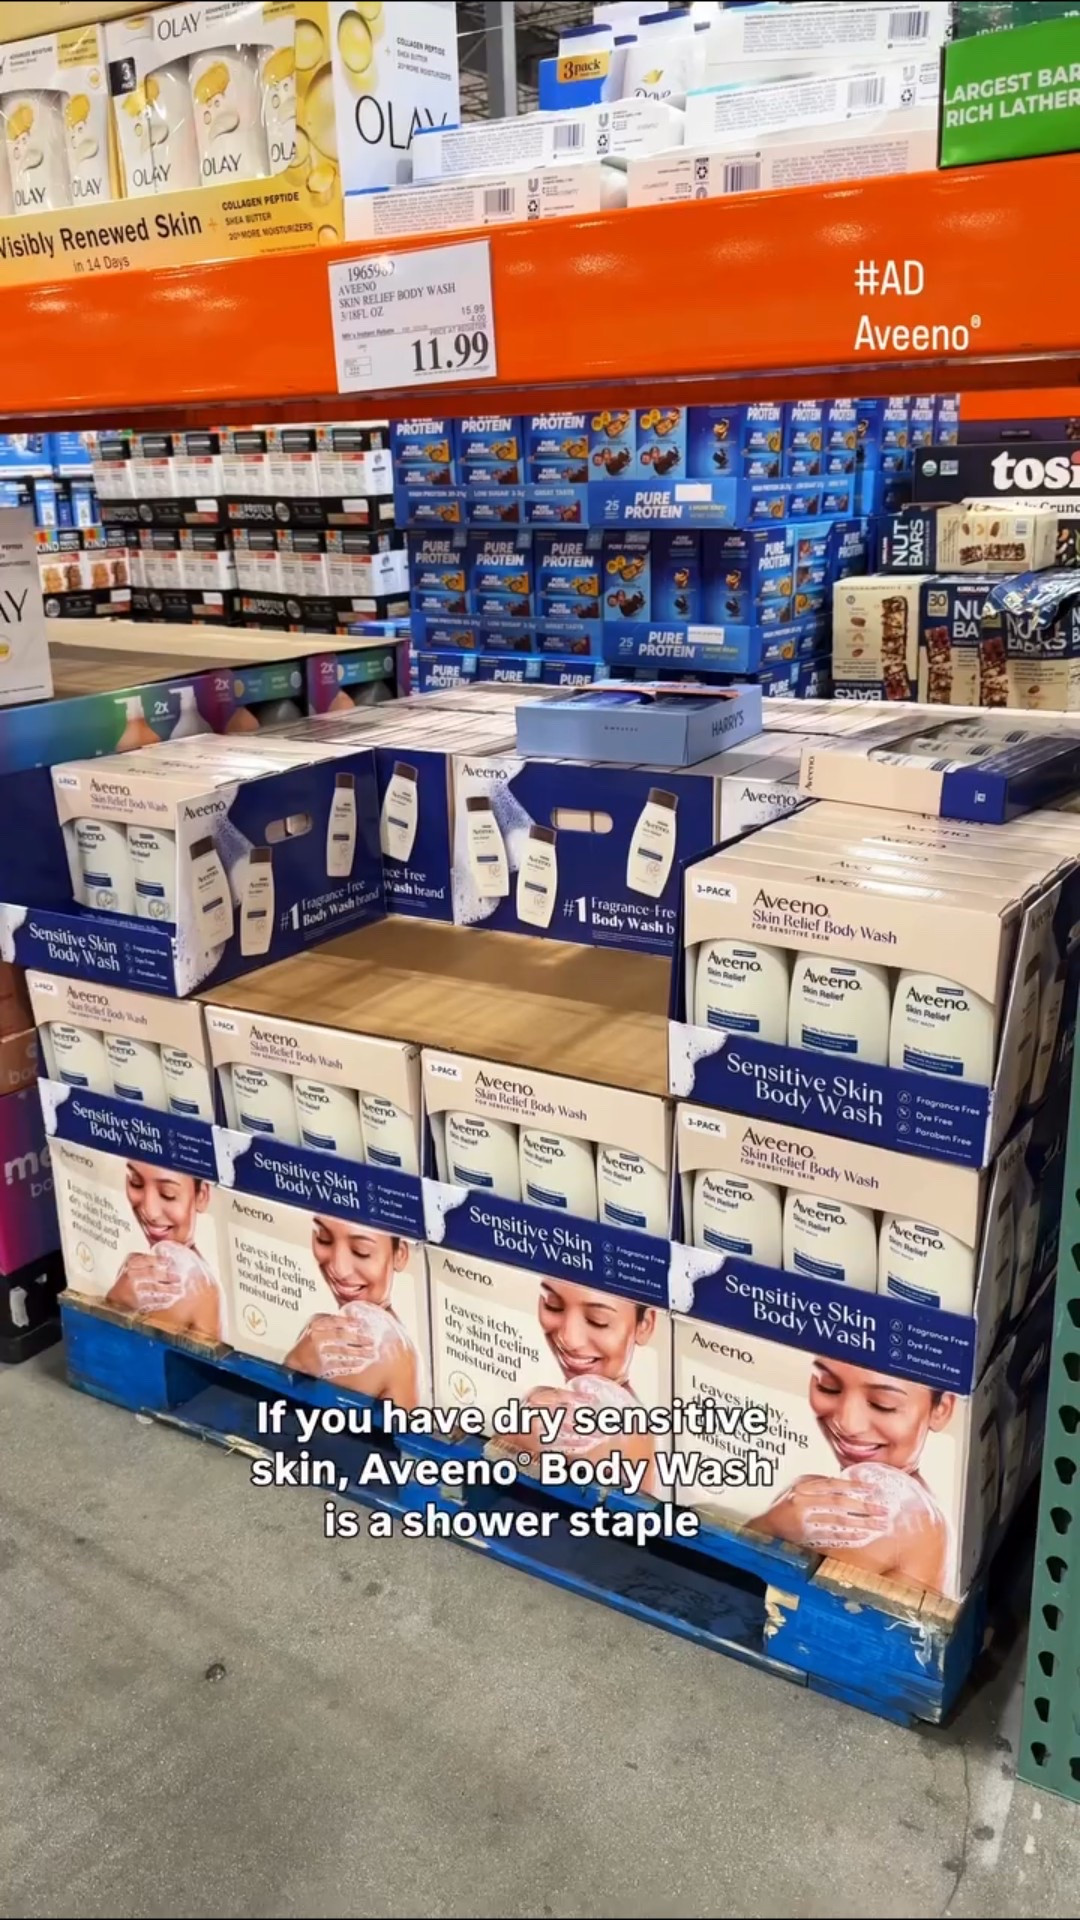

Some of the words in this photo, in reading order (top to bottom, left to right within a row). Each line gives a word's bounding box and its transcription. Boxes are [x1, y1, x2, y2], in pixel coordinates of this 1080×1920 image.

[157, 11, 201, 41] OLAY
[121, 62, 131, 81] 3
[944, 72, 1032, 105] LARGEST
[946, 103, 993, 128] RICH
[132, 163, 172, 187] OLAY
[202, 153, 242, 177] OLAY
[15, 187, 46, 207] OLAY
[222, 196, 262, 211] COLLAGEN
[264, 191, 300, 205] PEPTIDE
[60, 217, 150, 251] Renewed
[155, 211, 202, 239] Skin
[225, 215, 244, 226] SHEA
[245, 212, 272, 223] BUTTER
[262, 222, 314, 236] MOISTURIZERS
[73, 259, 85, 272] in
[87, 258, 101, 271] 14
[104, 255, 130, 271] Days
[338, 281, 377, 296] AVEENO
[339, 297, 361, 309] SKIN
[363, 291, 395, 306] RELIEF
[397, 286, 424, 301] BODY
[426, 282, 456, 295] WASH
[370, 306, 384, 318] OZ
[461, 303, 485, 316] 15.99
[411, 331, 489, 373] 11.99
[604, 500, 620, 511] 25
[634, 491, 671, 505] PURE
[624, 505, 683, 519] PROTEIN
[422, 540, 450, 552] PURE
[484, 541, 514, 554] PURE
[551, 543, 583, 555] PURE
[892, 520, 909, 566] NUT
[909, 519, 924, 566] BARS
[415, 552, 460, 564] PROTEIN
[476, 554, 525, 566] PROTEIN
[542, 555, 594, 568] PROTEIN
[928, 593, 946, 608] 30
[618, 637, 634, 648] 25
[648, 631, 684, 645] PURE
[638, 644, 696, 658] PROTEIN
[432, 664, 460, 676] PURE
[711, 709, 745, 737] HARRY'S
[696, 884, 732, 898] 3-PACK
[752, 888, 829, 918] Aveeno
[280, 902, 300, 931] #1
[302, 880, 366, 911] Fragrance-Free
[563, 896, 587, 923] #1
[29, 922, 87, 949] Sensitive
[751, 922, 767, 931] FOR
[769, 925, 809, 939] SENSITIVE
[811, 931, 830, 942] SKIN
[752, 909, 780, 925] Skin
[783, 913, 820, 931] Relief
[824, 920, 858, 938] Body
[860, 926, 898, 945] Wash
[47, 942, 81, 968] Body
[803, 967, 862, 991] Aveeno
[906, 986, 969, 1012] Aveeno
[249, 1025, 299, 1048] Aveeno
[270, 1045, 294, 1058] Relief
[474, 1070, 534, 1096] Aveeno
[726, 1052, 827, 1093] Sensitive
[832, 1075, 884, 1105] Skin
[498, 1092, 528, 1109] Relief
[756, 1080, 813, 1115] Body
[817, 1094, 883, 1126] Wash
[916, 1095, 960, 1114] Fragrance
[72, 1100, 129, 1130] Sensitive
[687, 1117, 721, 1133] 3-PACK
[915, 1111, 932, 1123] Dye
[125, 1131, 163, 1155] Wash
[741, 1126, 814, 1159] Aveeno
[915, 1127, 952, 1141] Paraben
[952, 1135, 972, 1147] Free
[253, 1151, 321, 1184] Sensitive
[324, 1171, 358, 1193] Skin
[740, 1157, 755, 1166] FOR
[757, 1162, 795, 1176] SENSITIVE
[741, 1145, 768, 1162] Skin
[770, 1152, 805, 1172] Relief
[809, 1160, 841, 1181] Body
[841, 1169, 879, 1189] Wash
[274, 1173, 313, 1200] Body
[315, 1184, 360, 1210] Wash
[469, 1205, 549, 1241] Sensitive
[552, 1227, 593, 1253] Skin
[234, 1237, 269, 1260] Leaves
[493, 1229, 538, 1260] Body
[542, 1243, 594, 1272] Wash
[616, 1245, 650, 1261] Fragrance
[236, 1252, 251, 1268] dry
[254, 1260, 276, 1276] skin
[277, 1267, 317, 1292] feeling
[237, 1268, 279, 1291] soothed
[281, 1285, 302, 1299] and
[442, 1258, 493, 1286] Aveeno
[239, 1281, 299, 1312] moisturized
[725, 1274, 822, 1317] Sensitive
[827, 1302, 876, 1332] Skin
[444, 1297, 485, 1325] Leaves
[486, 1315, 523, 1340] itchy,
[753, 1301, 808, 1336] Body
[813, 1317, 876, 1352] Wash
[445, 1314, 463, 1332] dry
[466, 1324, 491, 1343] skin
[494, 1333, 540, 1363] feeling
[691, 1332, 754, 1363] Aveeno
[906, 1338, 922, 1351] Dye
[923, 1343, 943, 1355] Free
[907, 1324, 949, 1343] Fragrance
[950, 1335, 969, 1347] Free
[445, 1331, 494, 1359] soothed
[497, 1352, 522, 1369] and
[446, 1346, 517, 1383] moisturized
[906, 1353, 941, 1369] Paraben
[941, 1363, 961, 1375] Free
[692, 1374, 741, 1406] Leaves
[755, 1437, 786, 1456] and
